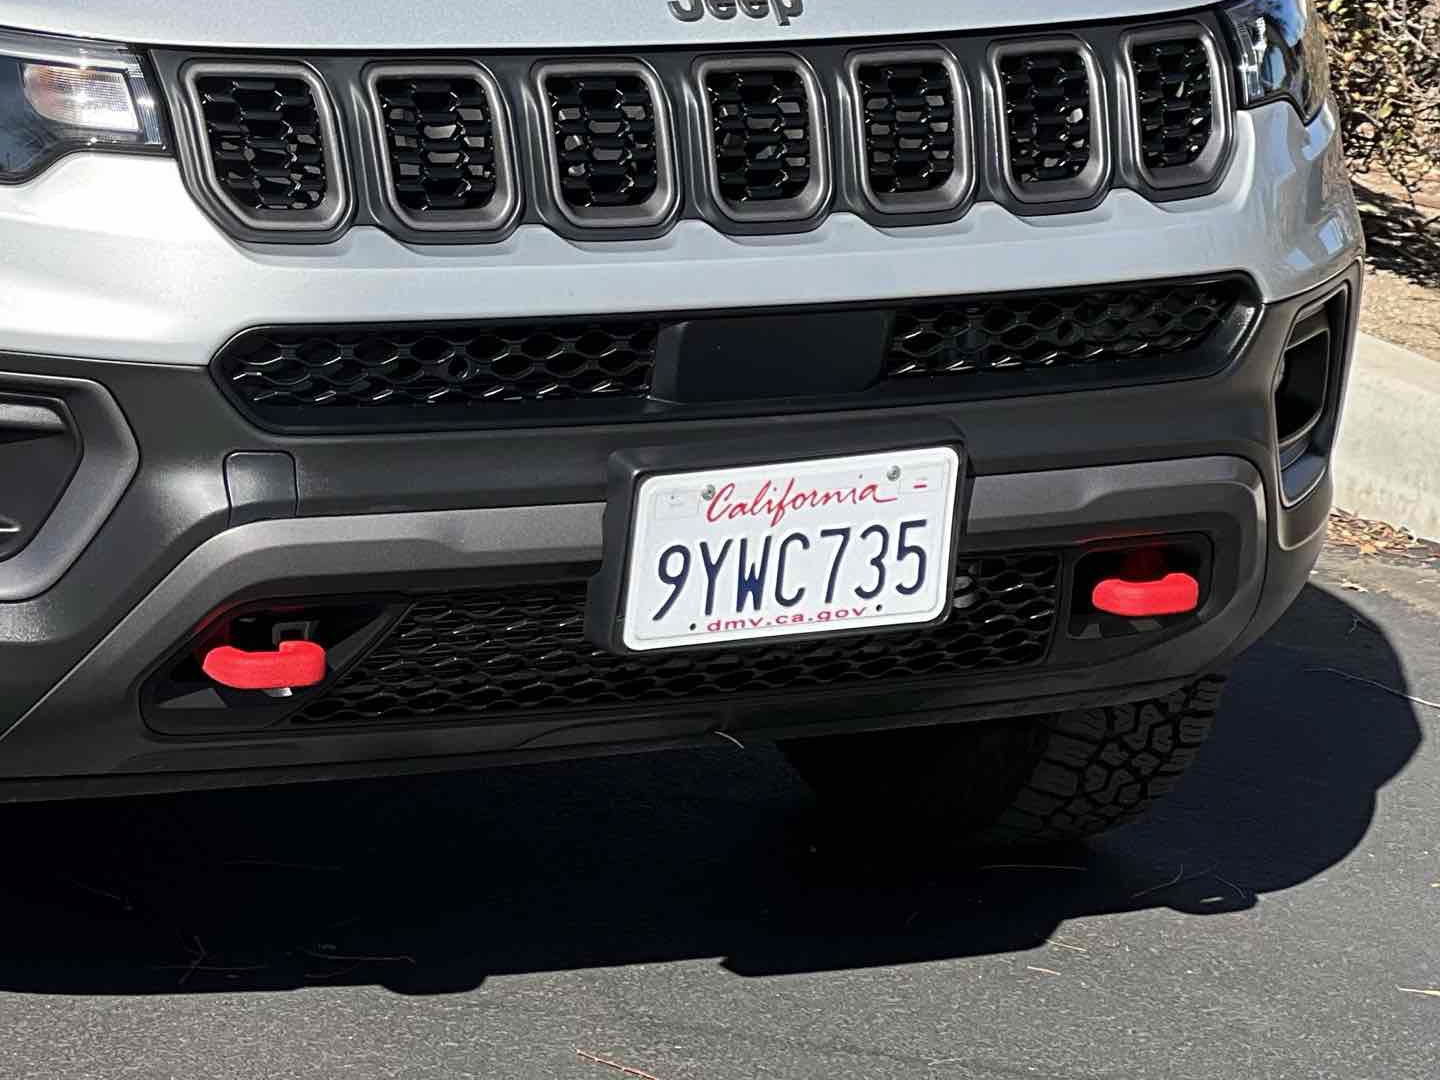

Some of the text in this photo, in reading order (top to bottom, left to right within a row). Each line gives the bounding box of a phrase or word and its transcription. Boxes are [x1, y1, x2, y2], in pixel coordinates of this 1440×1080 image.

[706, 478, 897, 527] California
[652, 519, 928, 621] 9YWC735
[706, 605, 869, 633] dmv.ca.gov
